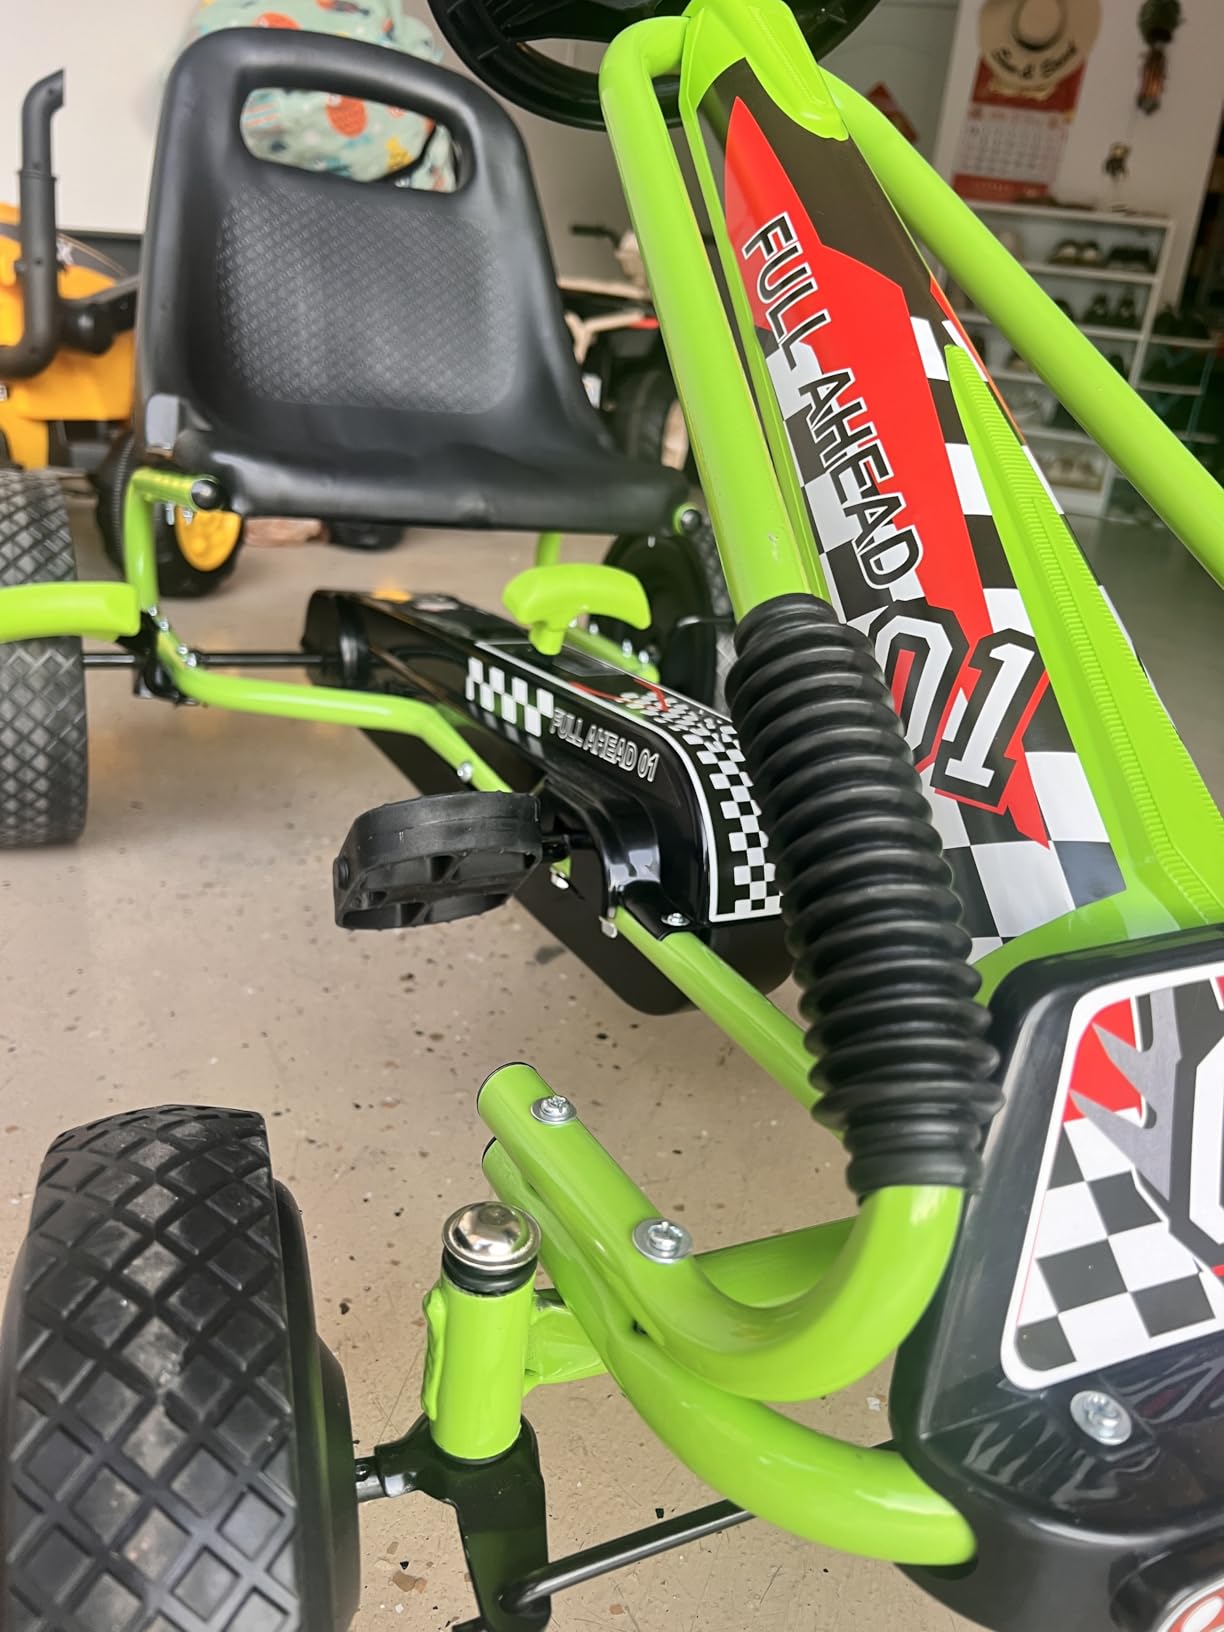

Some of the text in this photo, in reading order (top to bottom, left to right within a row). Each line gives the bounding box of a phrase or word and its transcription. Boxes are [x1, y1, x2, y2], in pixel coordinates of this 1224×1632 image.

[742, 212, 923, 590] FULL AHEAD
[550, 707, 660, 782] FULL AHEAD 01
[870, 612, 1038, 792] 01
